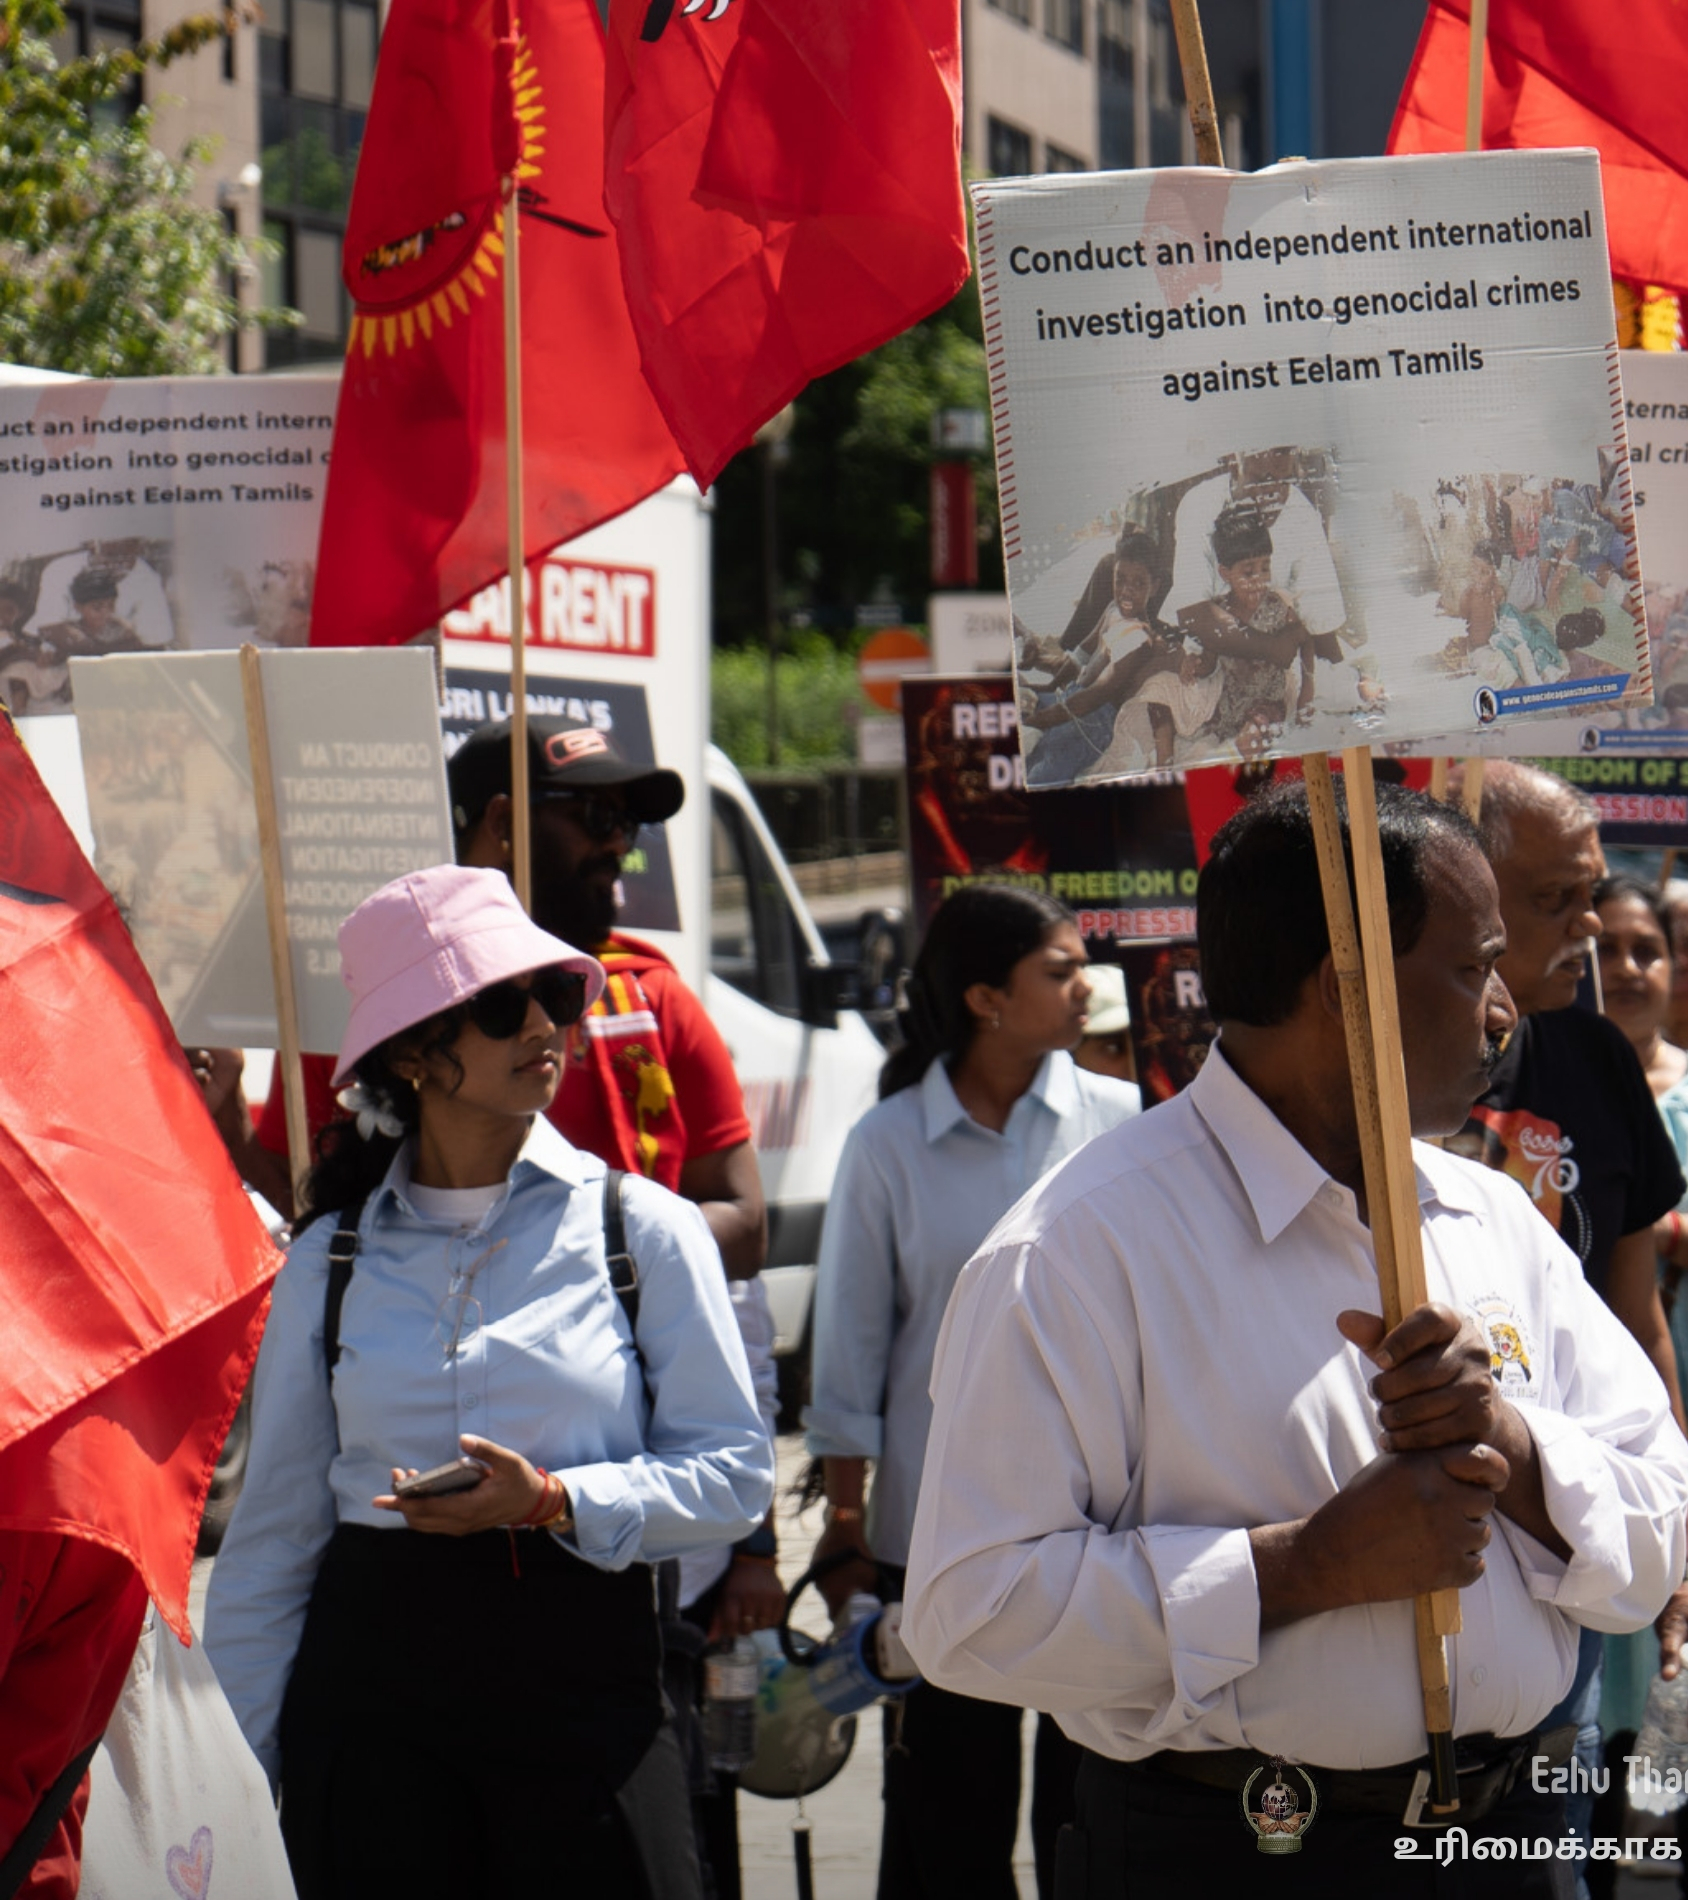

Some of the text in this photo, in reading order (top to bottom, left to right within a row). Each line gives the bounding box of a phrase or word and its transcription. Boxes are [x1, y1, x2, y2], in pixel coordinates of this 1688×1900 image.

[1010, 210, 1592, 275] Conduct an independent international
[1036, 275, 1581, 340] investigation into genocidal crimes
[1163, 342, 1484, 402] against Eelam Tamils
[43, 420, 74, 436] an
[83, 413, 249, 437] independent
[0, 452, 113, 477] stigation
[128, 450, 178, 468] into
[186, 447, 313, 471] genocidal
[41, 482, 314, 511] against Eelam Tamils
[541, 564, 650, 649] RENT
[489, 691, 612, 732] LNKA'S
[953, 703, 1018, 739] REP
[1641, 761, 1676, 785] OF
[1594, 793, 1688, 823] ESSION
[1052, 870, 1175, 899] FREEDOM
[1179, 870, 1198, 896] O
[1076, 907, 1197, 939] PPRESSI
